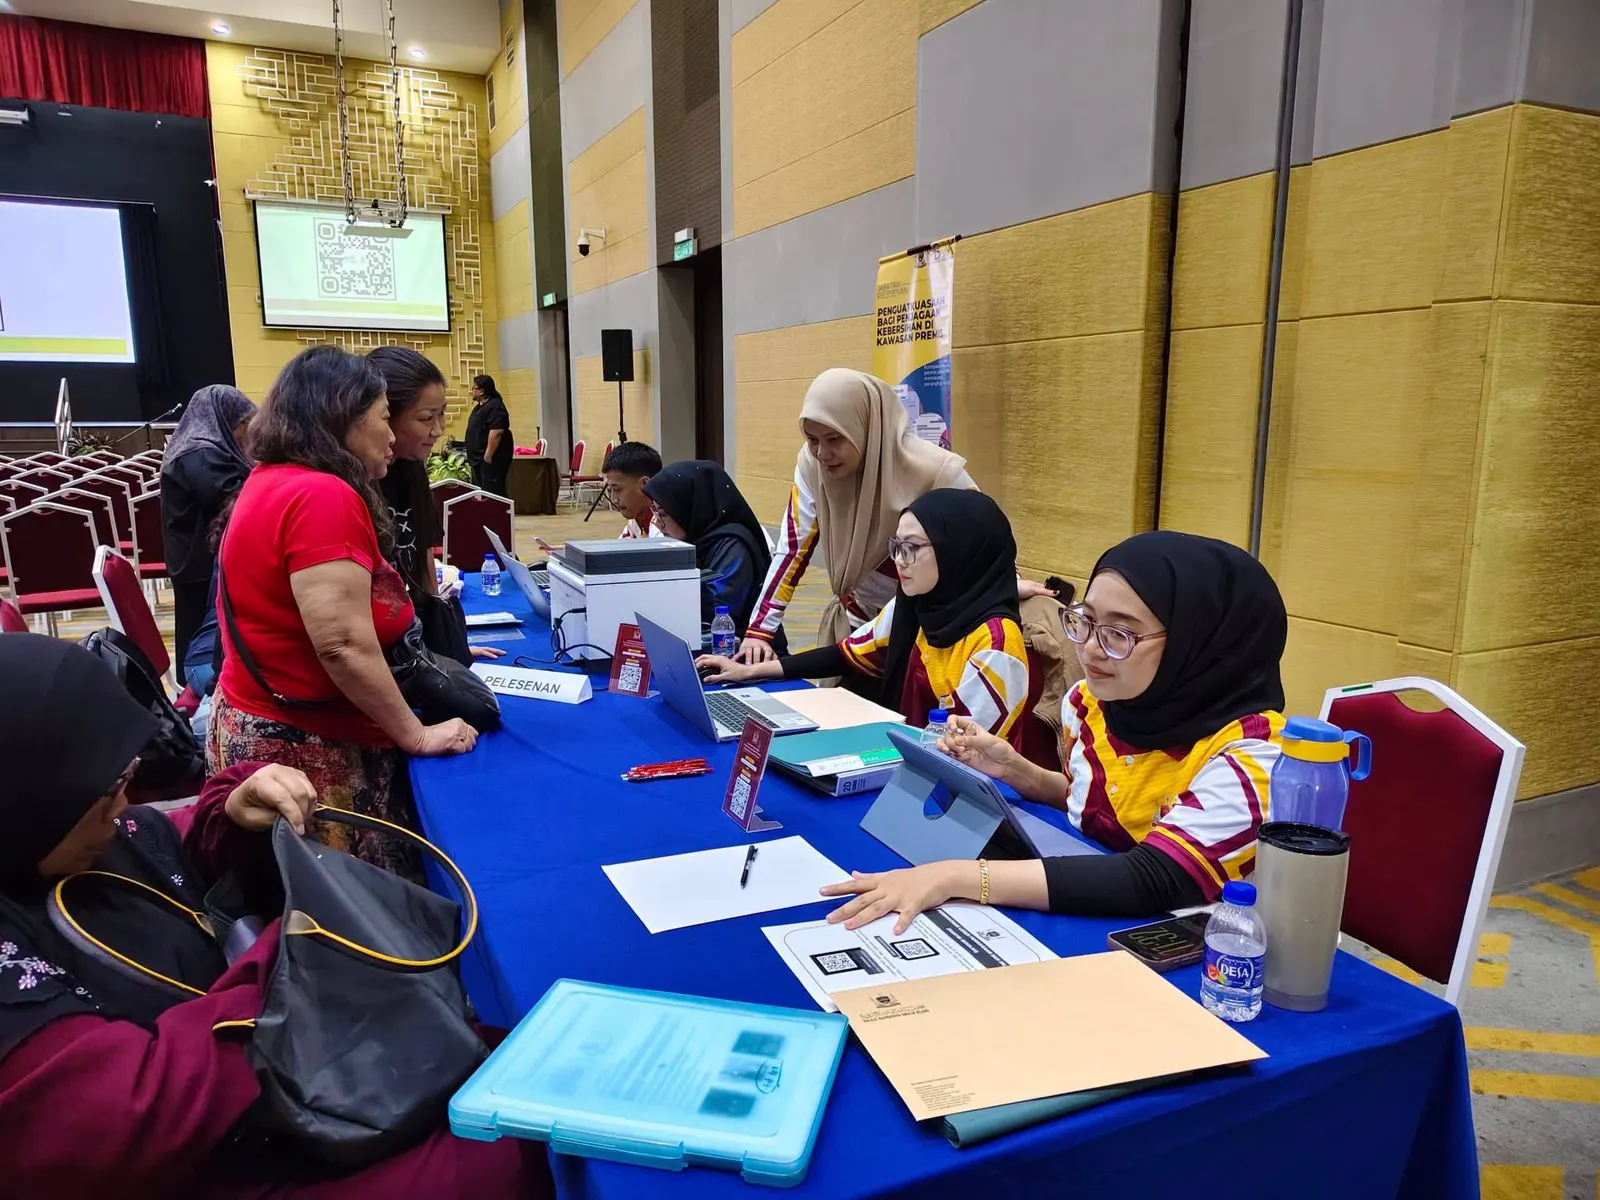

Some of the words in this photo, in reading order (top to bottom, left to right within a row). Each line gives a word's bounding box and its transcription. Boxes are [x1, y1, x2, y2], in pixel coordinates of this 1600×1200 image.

[877, 296, 945, 317] PENGUATKUASAAN
[877, 314, 896, 327] BAGI
[896, 308, 941, 324] PENJAGAAN
[876, 321, 923, 337] KEBERSIHAN
[924, 319, 934, 330] DI
[876, 333, 914, 346] KAWASAN
[914, 328, 944, 341] PREMIS
[484, 676, 561, 694] PELESENAN
[1220, 963, 1250, 979] DESA
